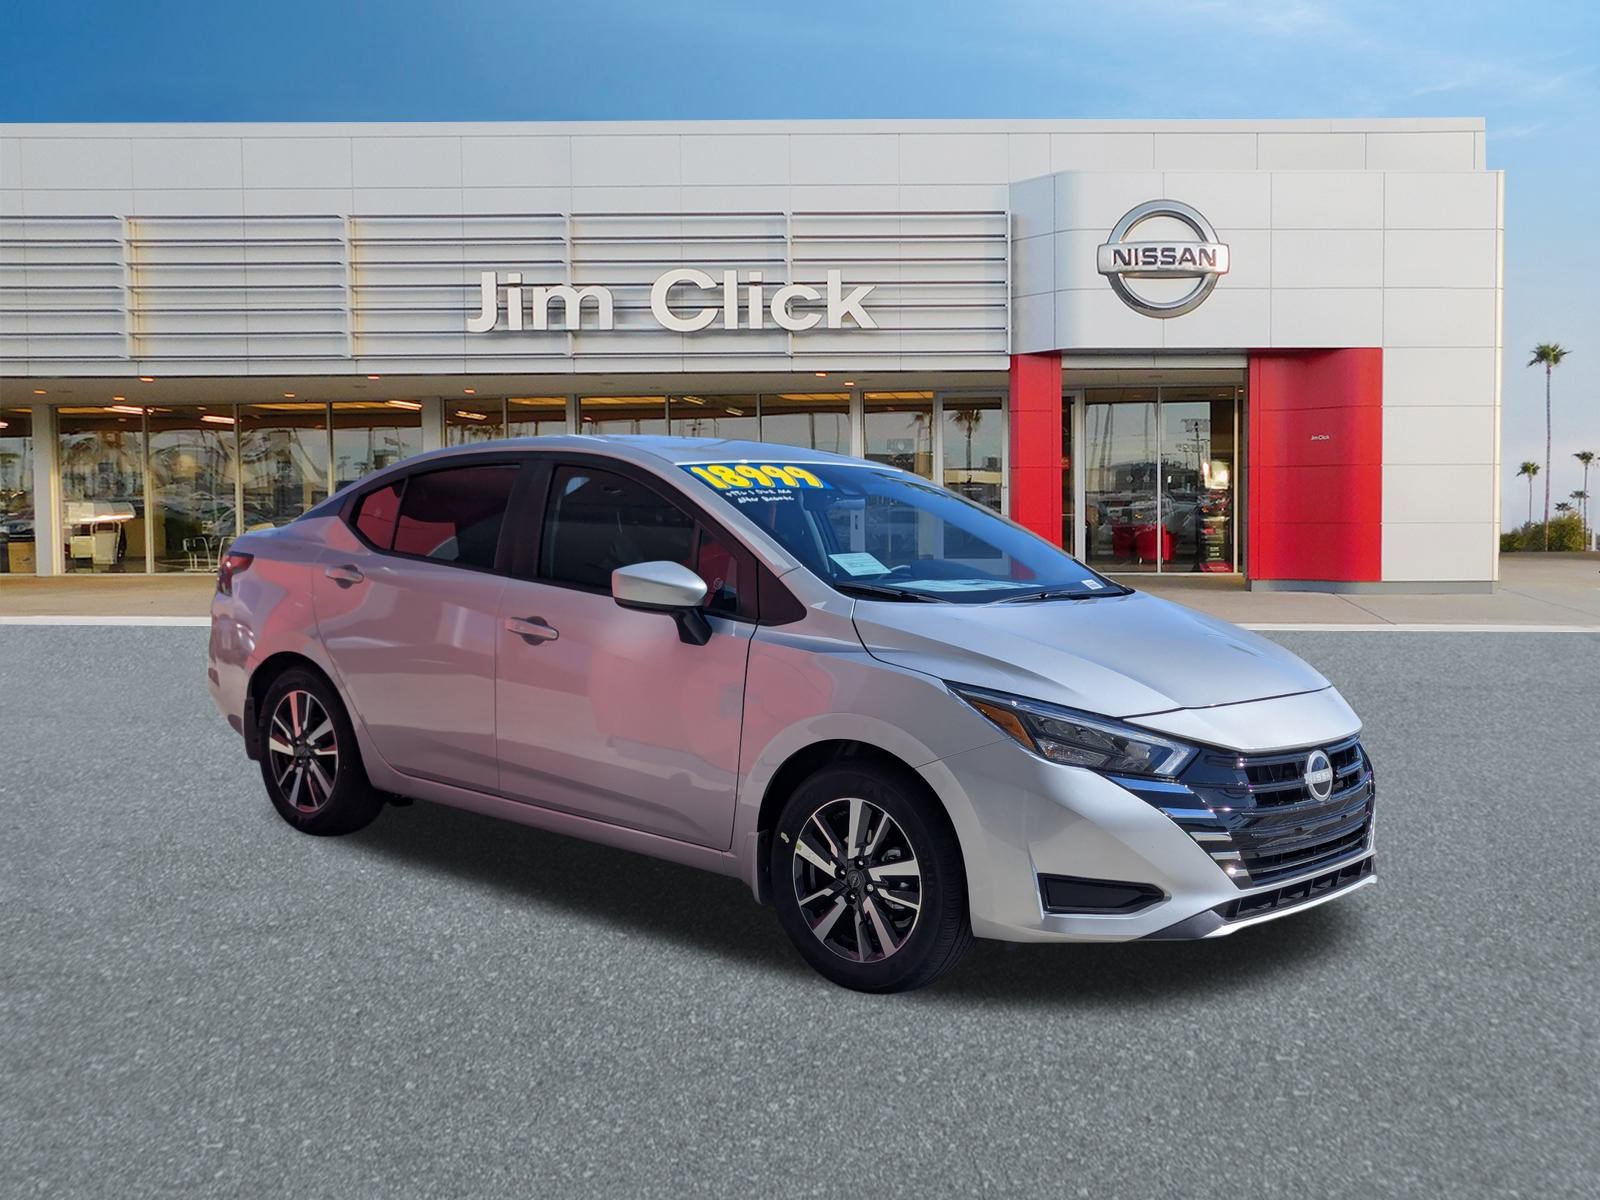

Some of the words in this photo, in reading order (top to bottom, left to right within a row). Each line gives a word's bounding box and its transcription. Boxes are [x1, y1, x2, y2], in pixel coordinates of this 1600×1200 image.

[1112, 247, 1217, 267] NISSAN
[467, 271, 614, 333] Jim
[650, 267, 880, 333] Click
[690, 464, 824, 490] 18999
